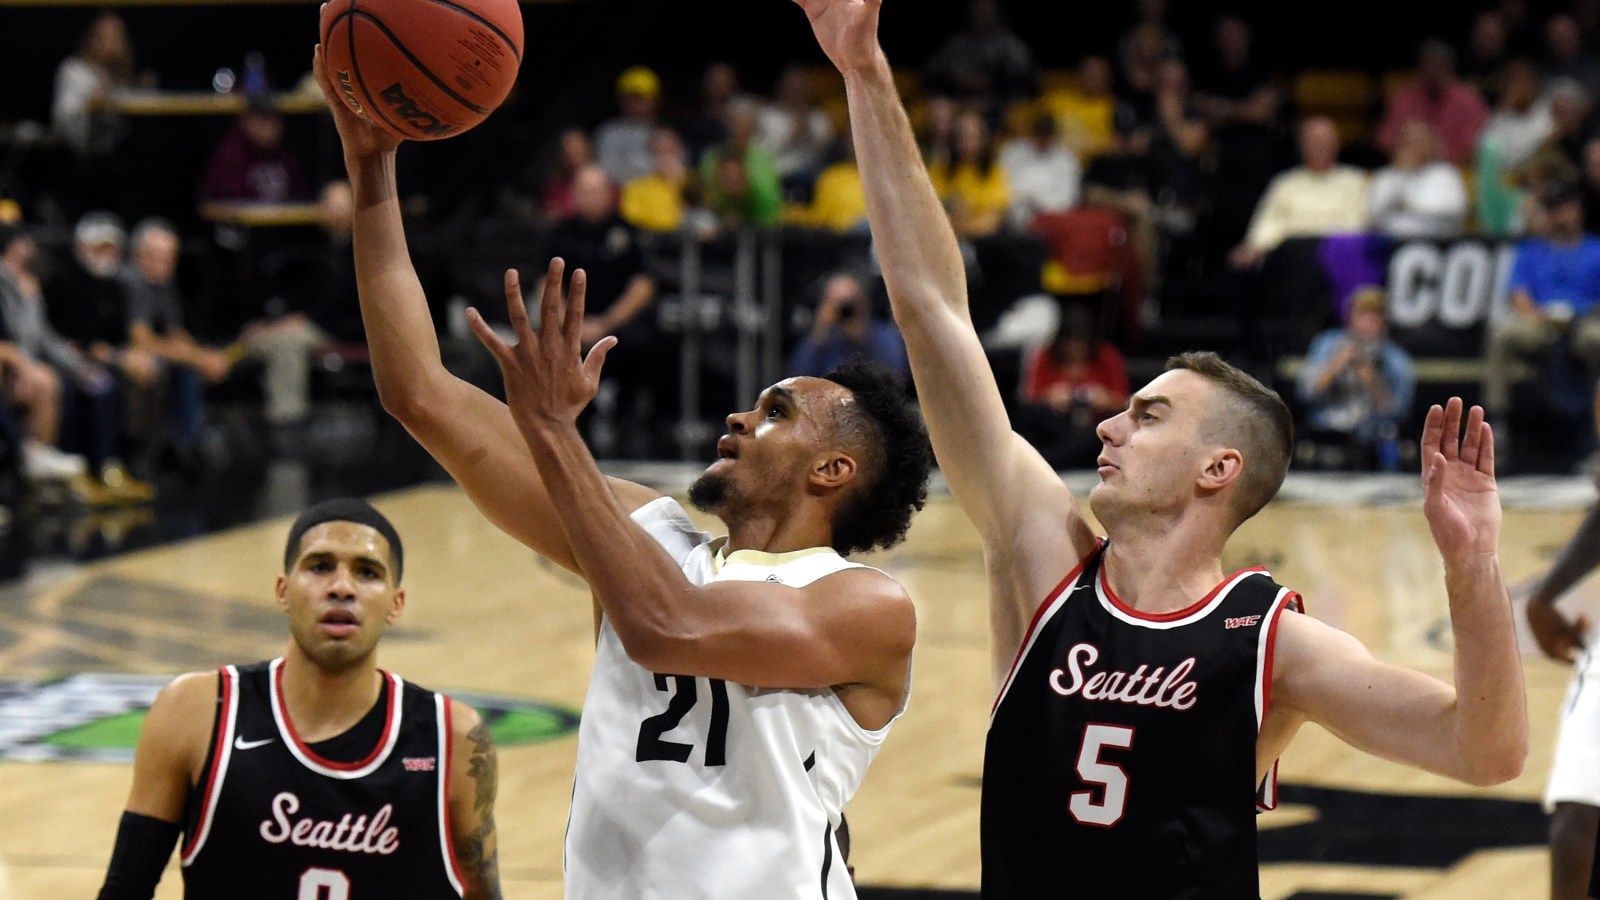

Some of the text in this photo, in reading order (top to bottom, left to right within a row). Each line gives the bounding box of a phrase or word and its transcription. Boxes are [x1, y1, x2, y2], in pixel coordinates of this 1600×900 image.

[1224, 614, 1262, 630] WAC
[1049, 642, 1198, 711] Seattle
[635, 672, 730, 767] 21
[1069, 721, 1136, 829] 5
[259, 791, 400, 855] Seattle
